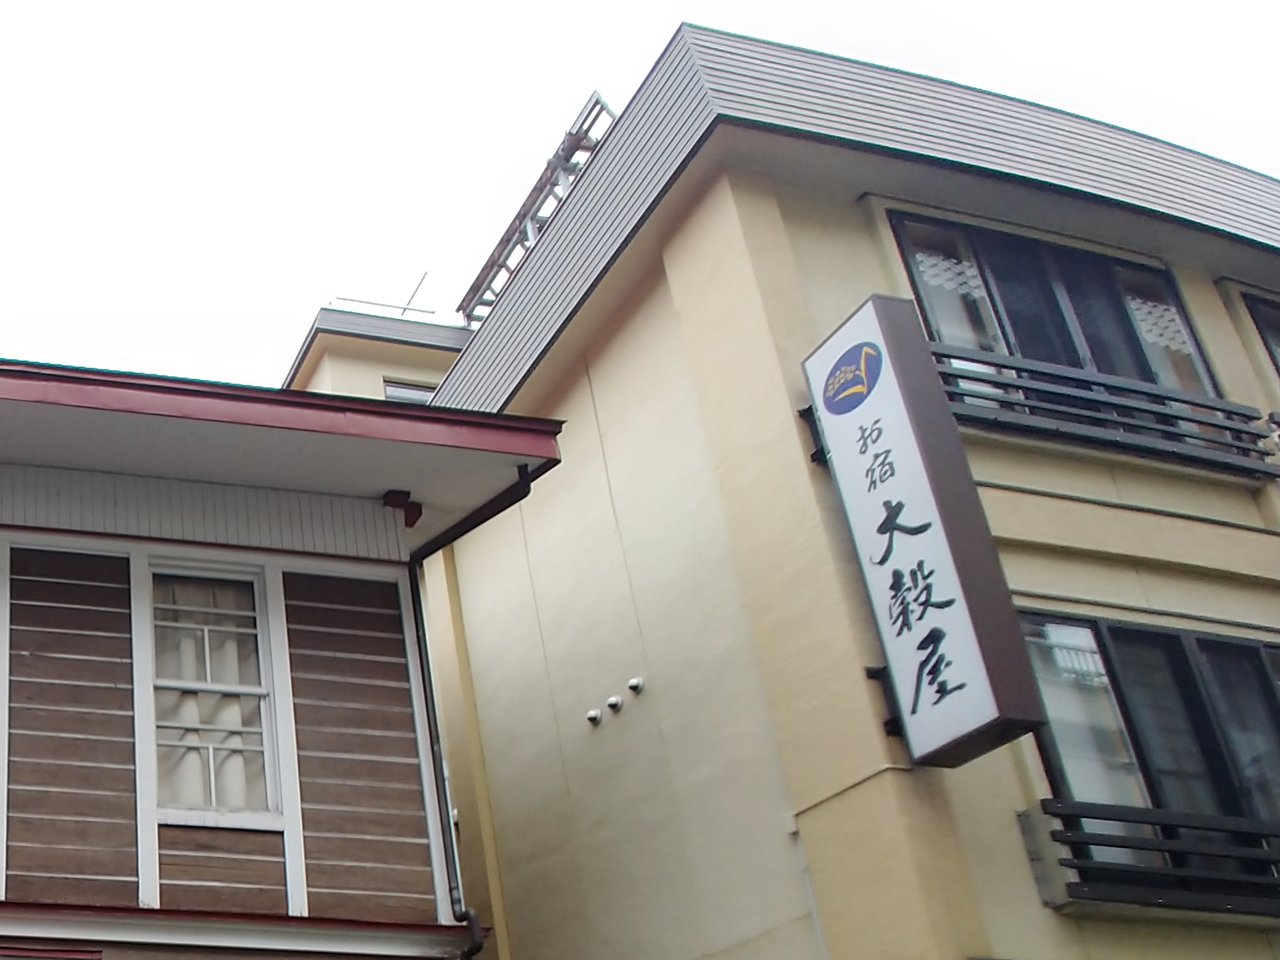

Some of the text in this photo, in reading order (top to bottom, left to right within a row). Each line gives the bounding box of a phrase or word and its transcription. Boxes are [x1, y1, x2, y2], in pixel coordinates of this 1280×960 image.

[855, 417, 969, 715] お宿 大穀屋
